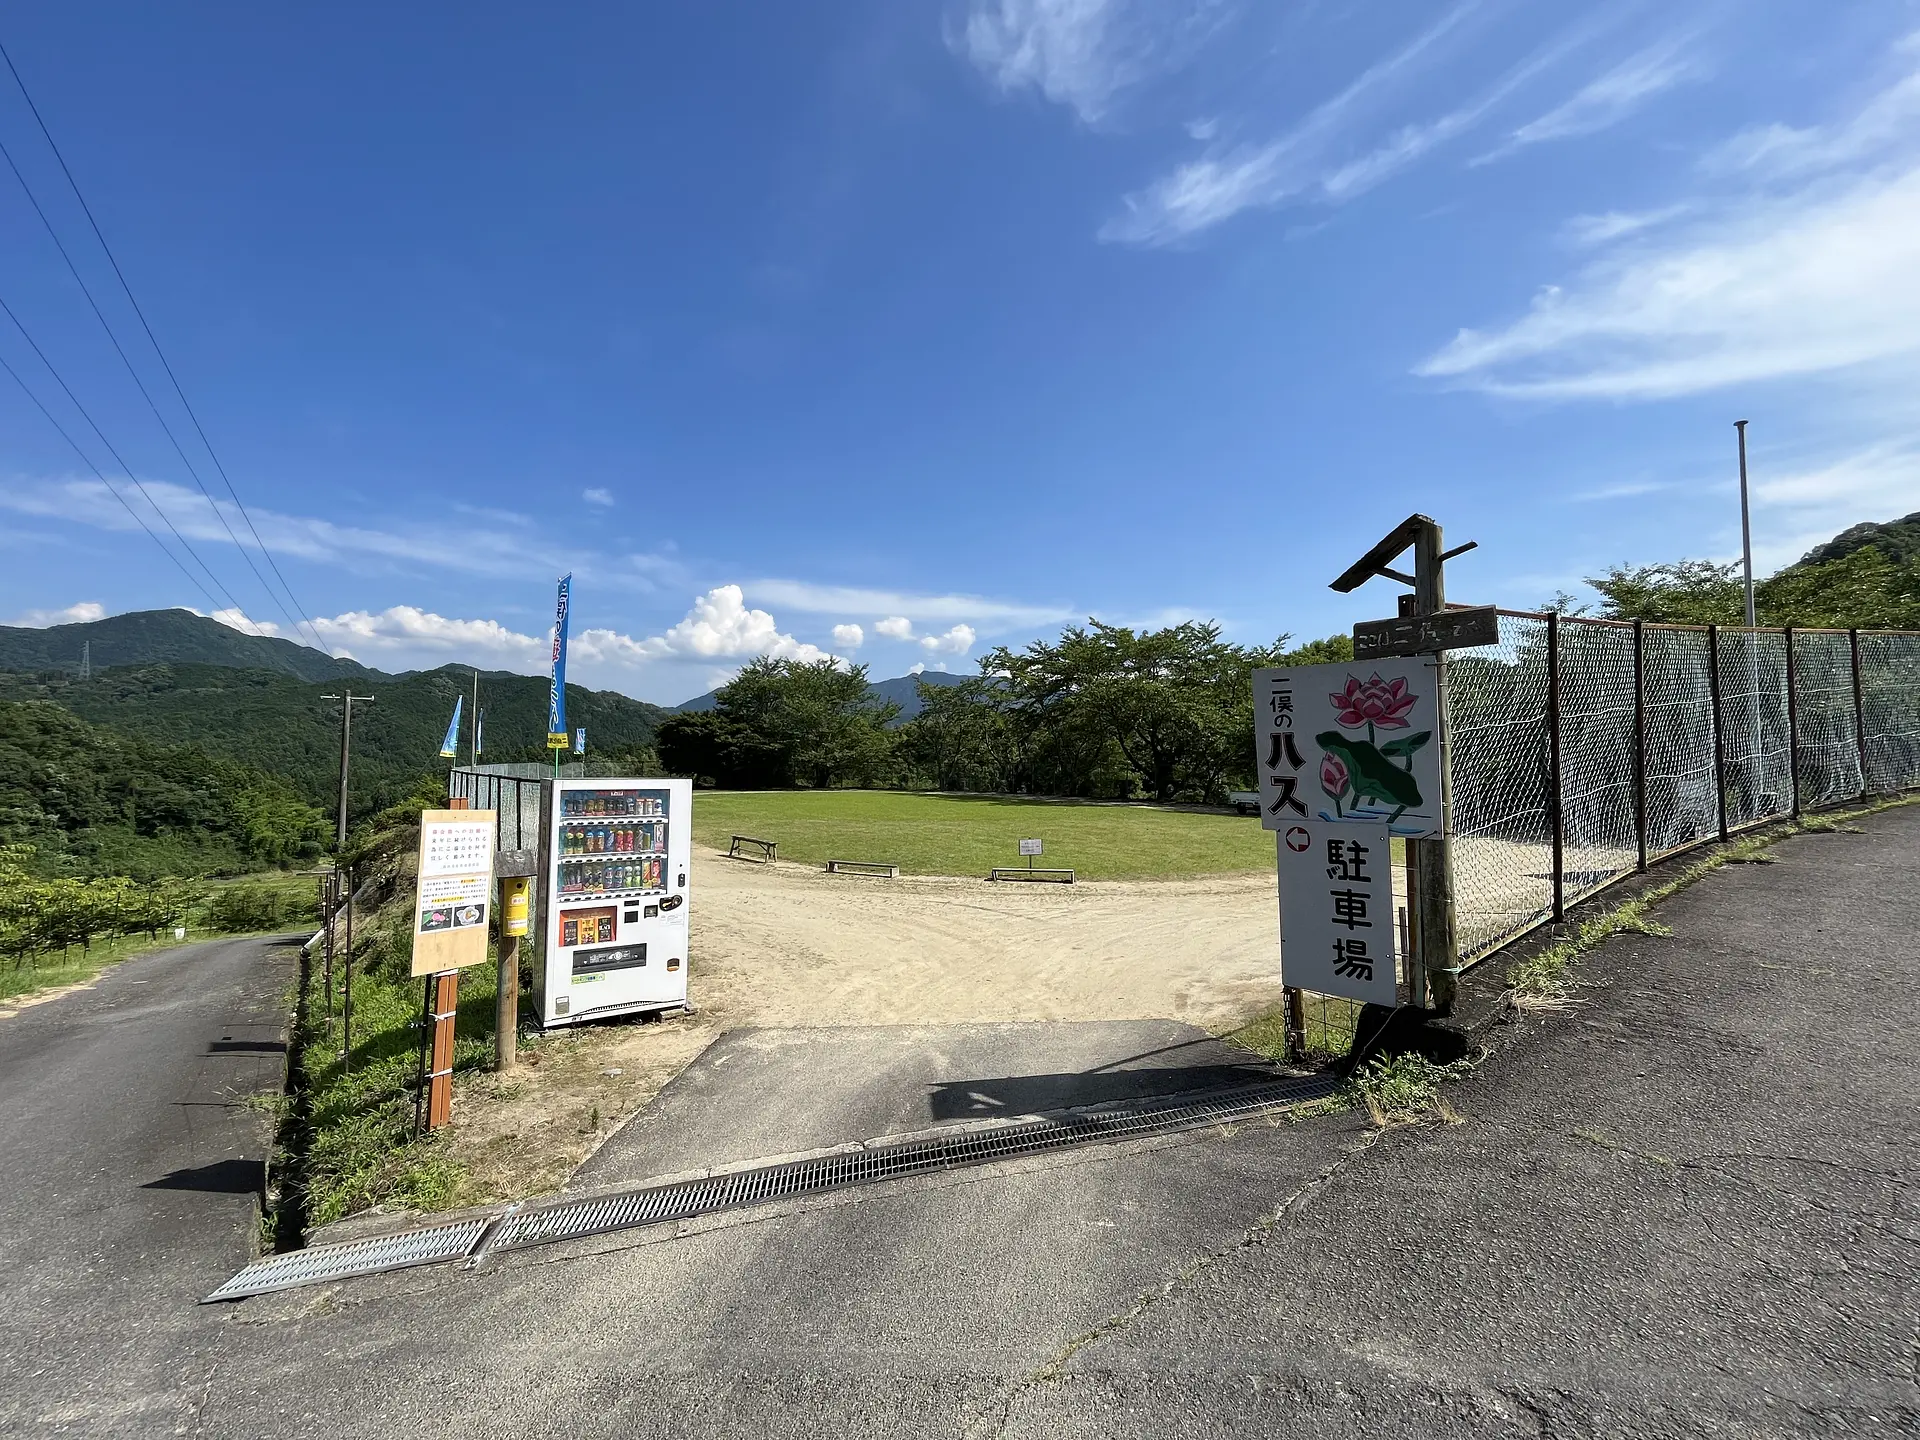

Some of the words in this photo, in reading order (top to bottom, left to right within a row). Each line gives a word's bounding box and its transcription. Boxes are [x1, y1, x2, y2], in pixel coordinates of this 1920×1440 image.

[1265, 677, 1309, 819] 二俣のハス
[1325, 838, 1374, 982] 駐車場
